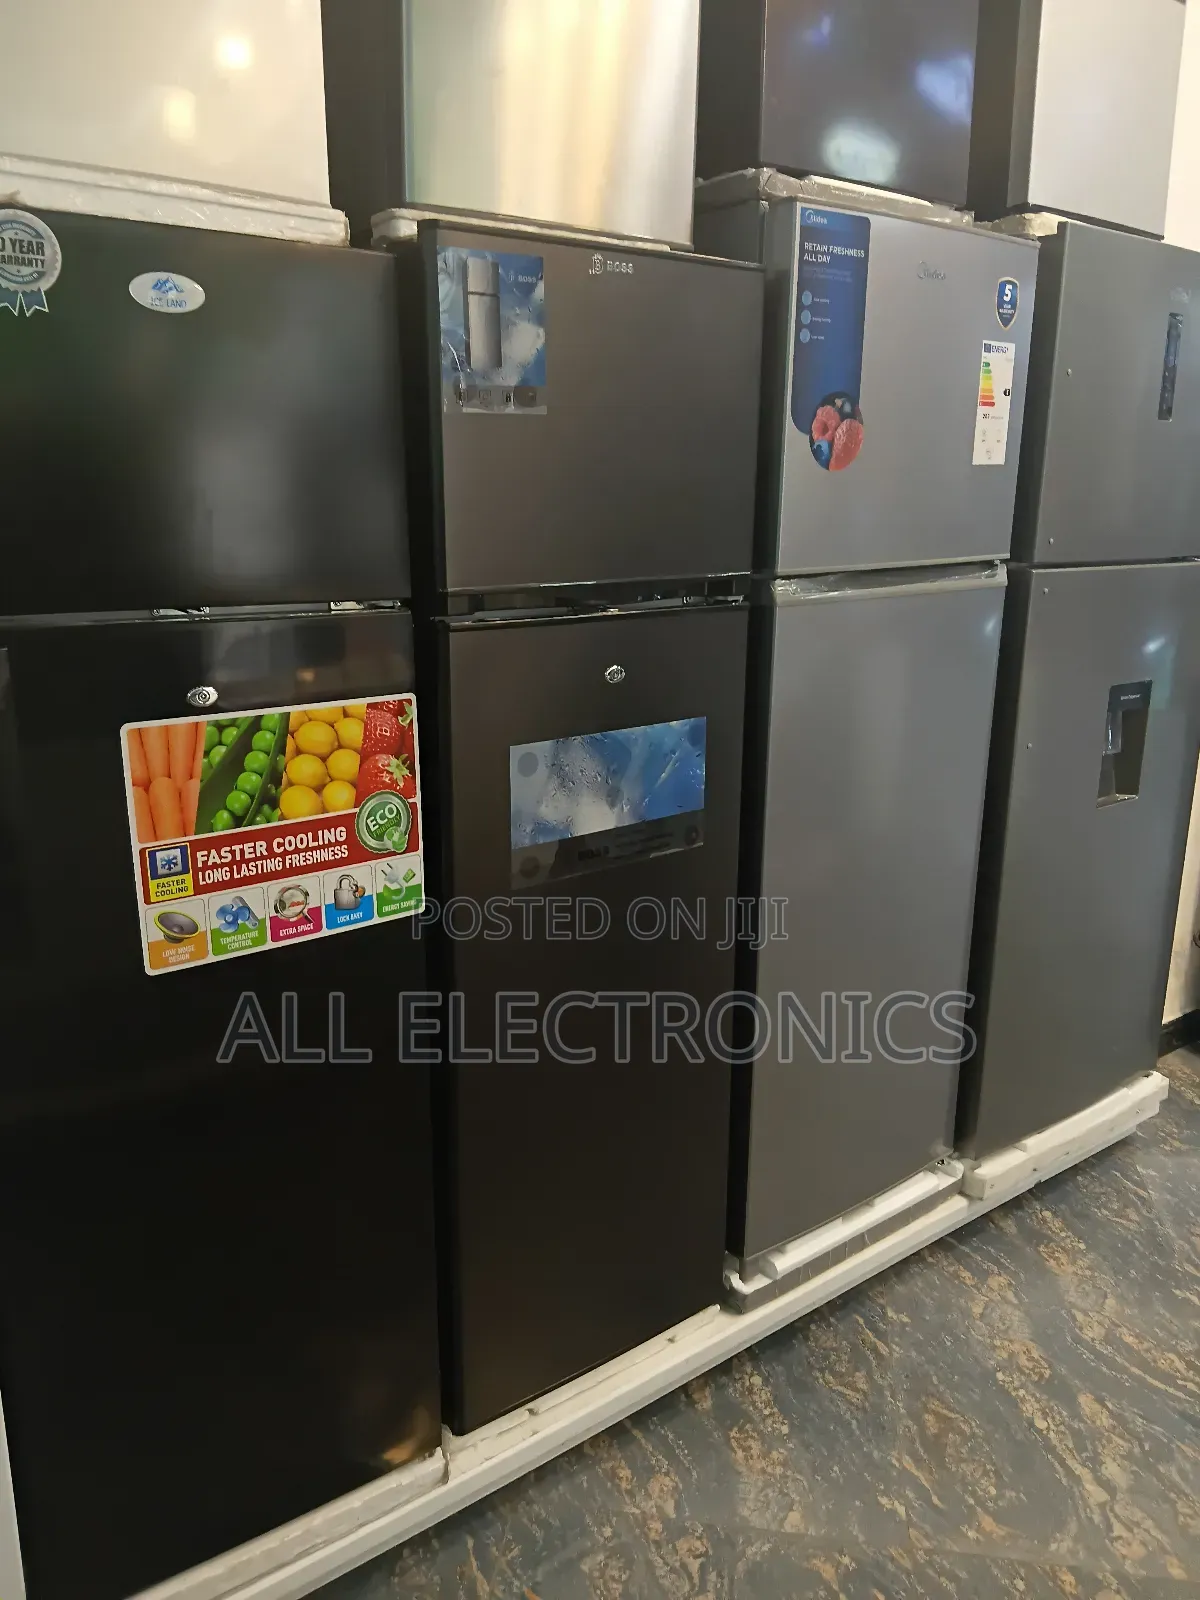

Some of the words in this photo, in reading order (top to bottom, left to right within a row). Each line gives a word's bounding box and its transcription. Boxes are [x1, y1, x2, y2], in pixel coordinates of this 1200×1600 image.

[9, 236, 46, 257] YEAR
[804, 241, 828, 253] RETAIN
[828, 245, 865, 258] FRESHNESS
[803, 252, 817, 262] ALL
[817, 254, 831, 264] DAY
[606, 260, 635, 275] BOSS
[1003, 283, 1013, 302] 5
[166, 298, 187, 308] LAND
[367, 803, 397, 832] ECO
[372, 813, 401, 837] FRIENDLY
[196, 839, 268, 868] FASTER
[272, 826, 347, 854] COOLING
[198, 868, 231, 886] LONG
[233, 857, 283, 880] LASTING
[286, 844, 349, 869] FRESHNESS
[155, 885, 189, 898] COOLING
[156, 878, 186, 890] FASTER
[279, 925, 297, 938] EXTRA
[297, 921, 314, 933] SPACE
[219, 930, 259, 946] TEMPERATURE
[226, 938, 253, 951] CONTROL
[162, 947, 177, 958] LOW
